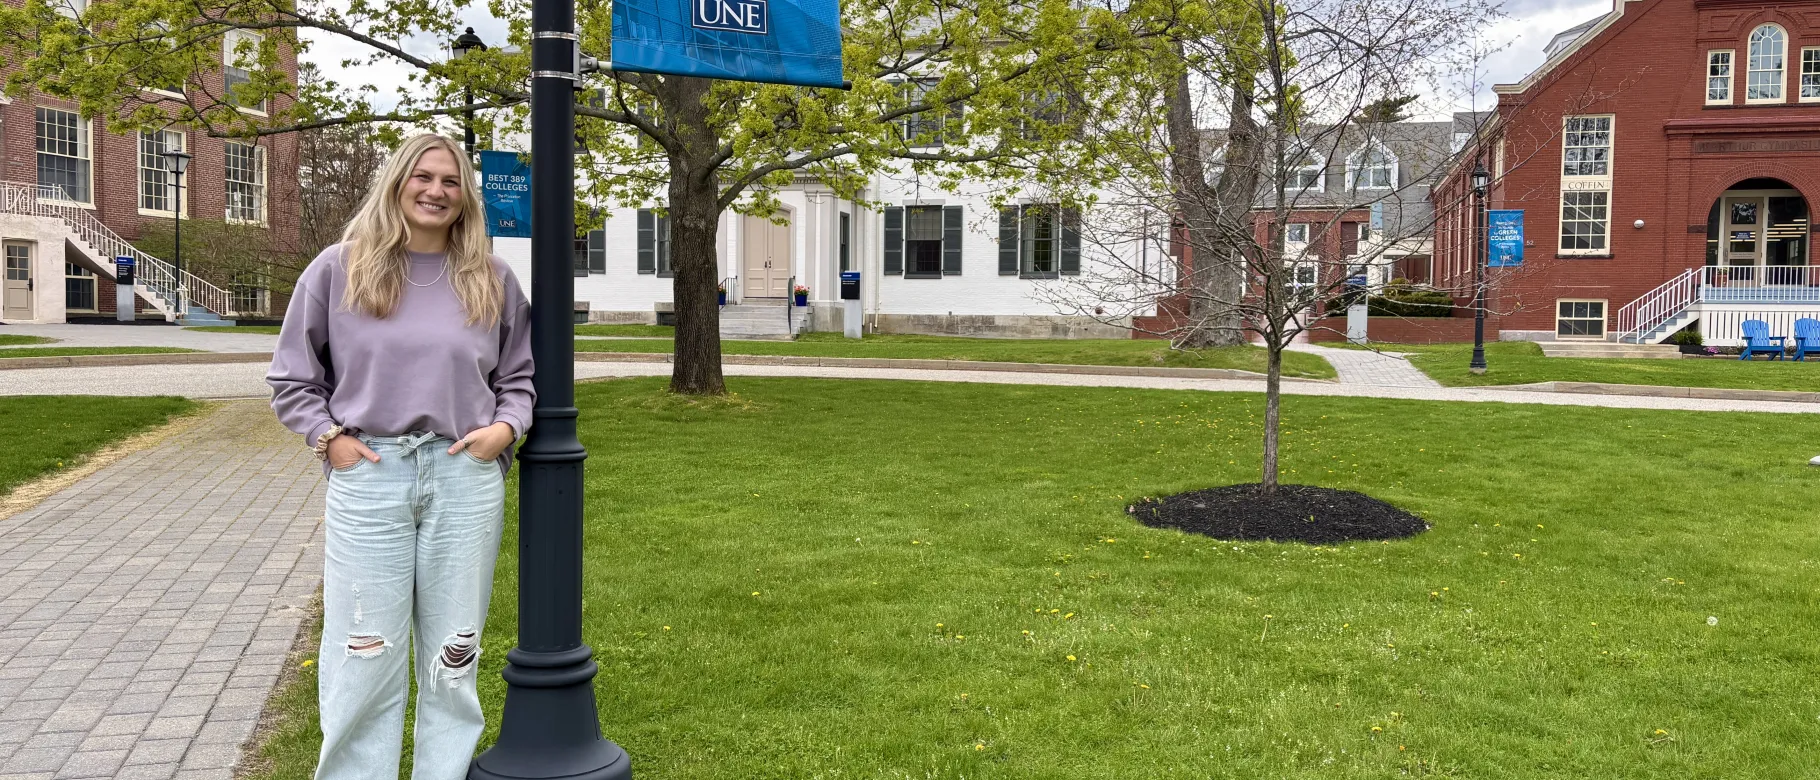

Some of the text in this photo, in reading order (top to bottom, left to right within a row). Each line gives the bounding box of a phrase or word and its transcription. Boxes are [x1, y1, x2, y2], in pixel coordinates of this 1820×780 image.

[700, 0, 761, 28] UNE
[488, 174, 526, 183] BEST 389
[485, 182, 528, 191] COLLEGES
[1568, 181, 1605, 189] COFFIN
